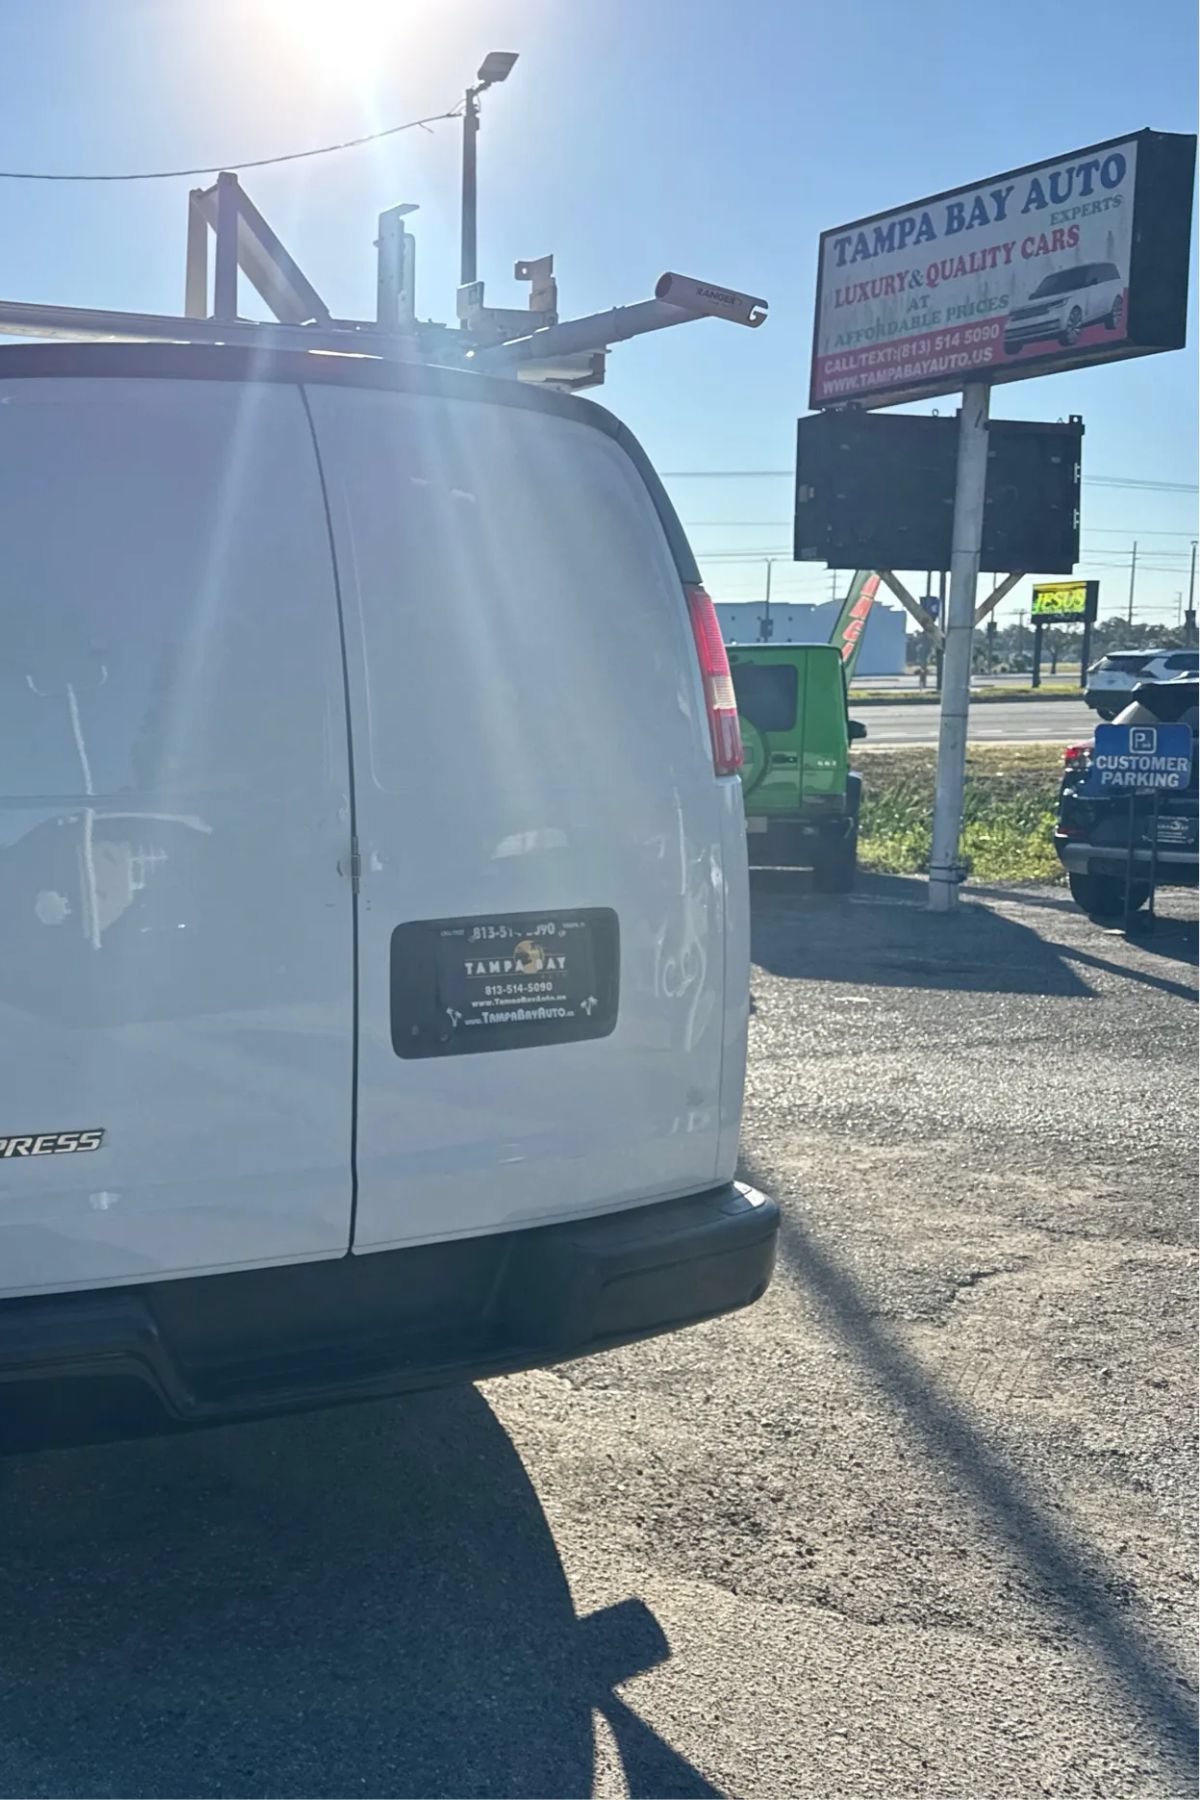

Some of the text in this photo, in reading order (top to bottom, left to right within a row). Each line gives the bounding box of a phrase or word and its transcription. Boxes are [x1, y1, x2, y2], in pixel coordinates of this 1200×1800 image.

[834, 152, 1127, 267] TAMPA BAY AUTO
[1050, 194, 1123, 226] EXPERTS
[1021, 224, 1081, 260] CARS
[906, 294, 931, 313] AT
[834, 294, 1010, 348] AFFORDABLE PRICES
[935, 331, 960, 351] 514
[964, 323, 1000, 345] 5090
[823, 347, 993, 395] WWW.TAMPABAYAUTO.US
[1032, 588, 1087, 615] JESUS
[1095, 755, 1189, 772] CUSTOMER
[1101, 771, 1180, 788] PARKING
[464, 960, 525, 976] TAMPA
[484, 982, 553, 996] 813-514-5090
